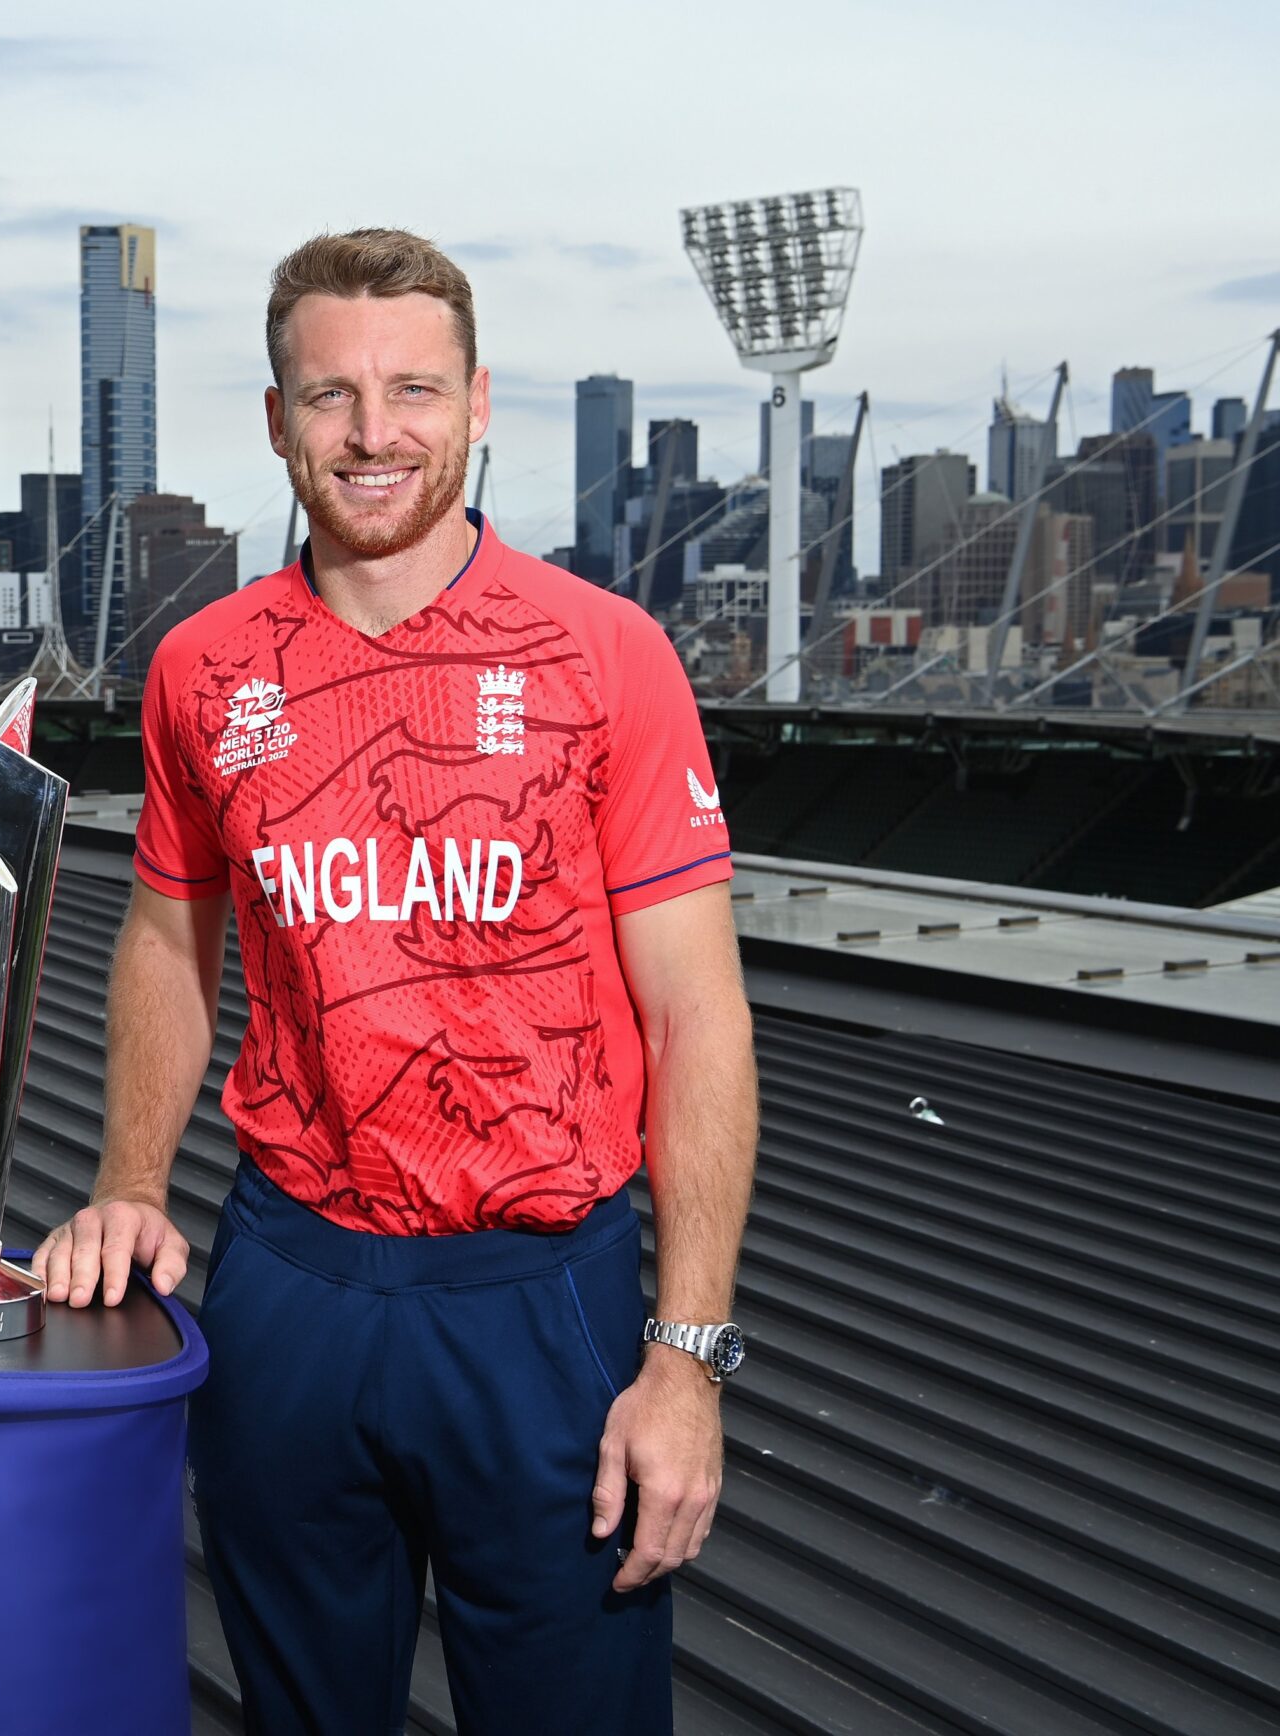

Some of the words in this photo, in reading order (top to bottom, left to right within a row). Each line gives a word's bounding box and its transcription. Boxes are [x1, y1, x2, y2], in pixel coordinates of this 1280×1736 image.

[772, 386, 786, 408] 6
[220, 731, 262, 753] MEN'S
[265, 722, 291, 739] T20
[223, 727, 239, 738] ICC
[213, 743, 265, 768] WORLD
[267, 733, 298, 751] CUP
[221, 756, 266, 777] AUSTRALIA
[268, 750, 288, 762] 2022
[690, 812, 726, 828] CASTO
[251, 837, 523, 928] ENGLAND
